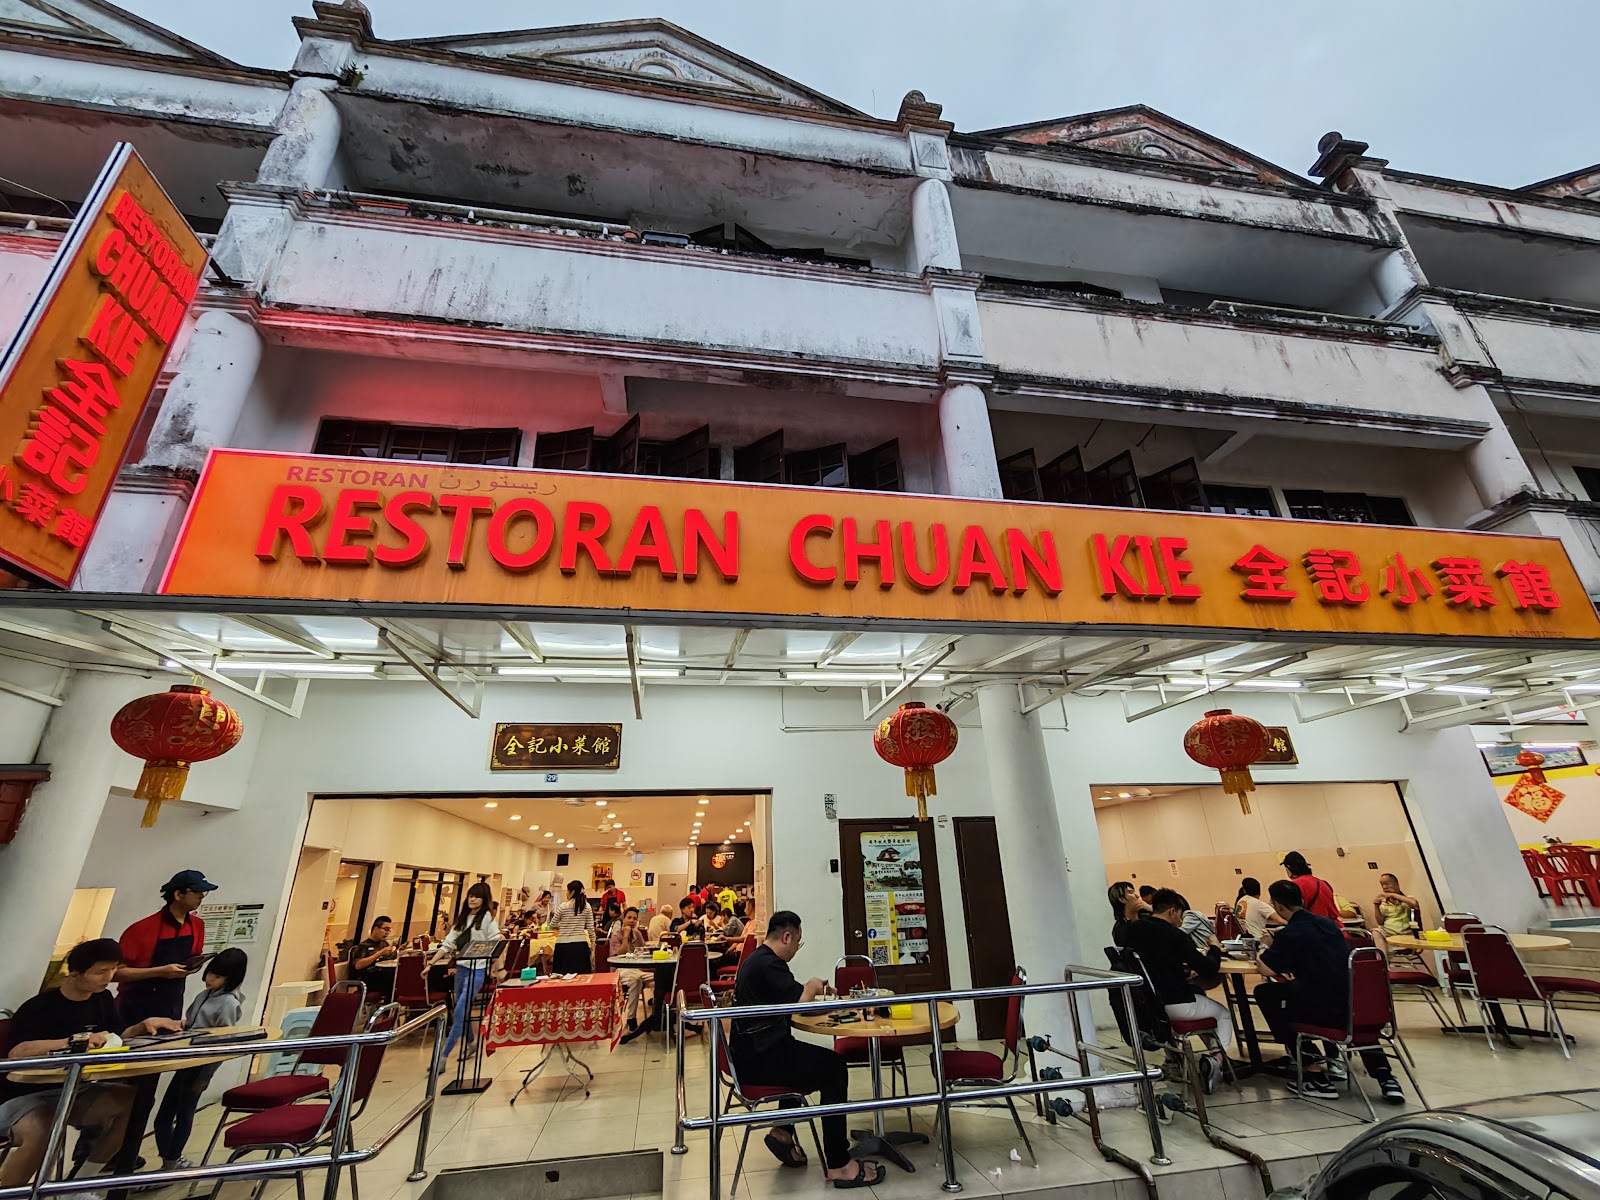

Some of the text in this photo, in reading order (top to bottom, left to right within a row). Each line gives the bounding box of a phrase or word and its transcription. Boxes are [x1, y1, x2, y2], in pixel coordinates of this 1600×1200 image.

[96, 228, 185, 344] CHUAN
[112, 190, 198, 304] RESTORAN
[87, 292, 148, 377] KIE
[21, 357, 122, 495] 全記
[285, 465, 429, 489] RESTORAN
[254, 484, 1202, 602] RESTORAN CHUAN KIE
[1231, 544, 1561, 609] 全記小菜館
[502, 734, 612, 756] 全記小菜館
